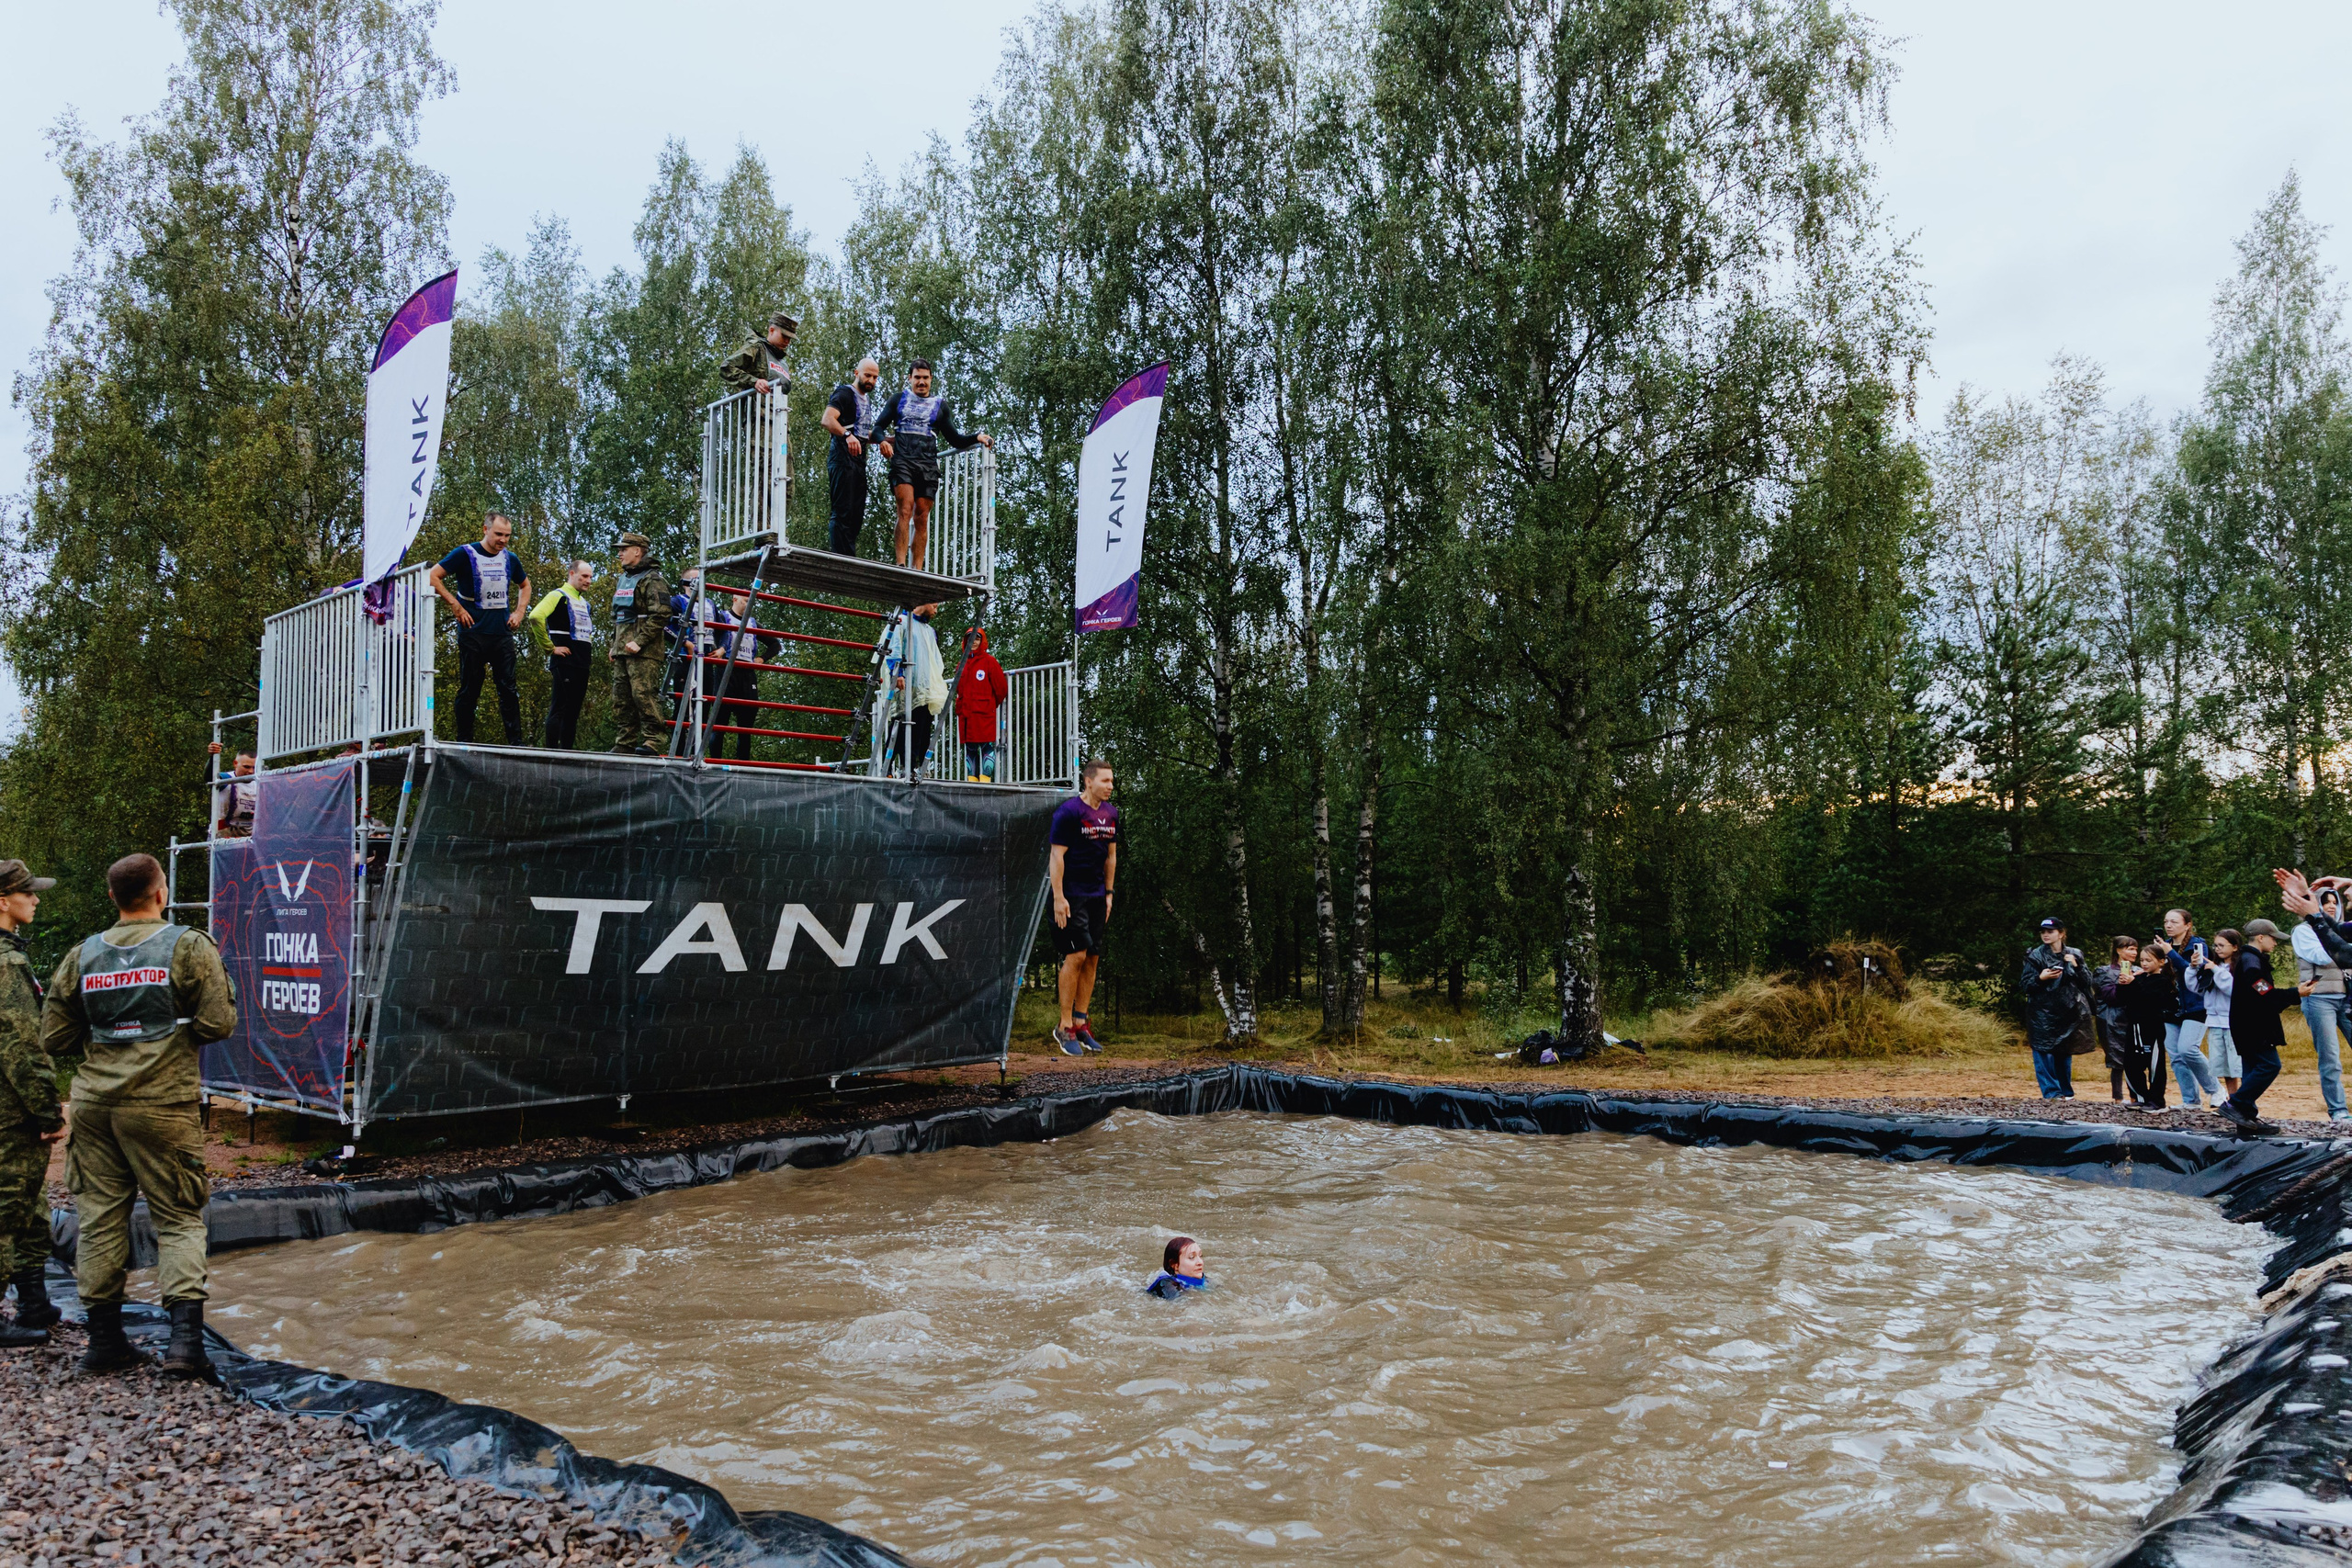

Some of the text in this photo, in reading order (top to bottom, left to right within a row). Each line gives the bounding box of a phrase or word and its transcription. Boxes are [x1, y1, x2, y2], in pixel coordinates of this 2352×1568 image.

[406, 395, 429, 531] TANK
[1105, 450, 1129, 553] TANK
[266, 932, 319, 964] ГОНКА
[530, 897, 967, 974] TANK
[85, 969, 166, 990] ИНСТРУКТОР
[262, 980, 321, 1014] ГЕРОЕВ
[113, 1028, 142, 1036] ГЕРОЕВ
